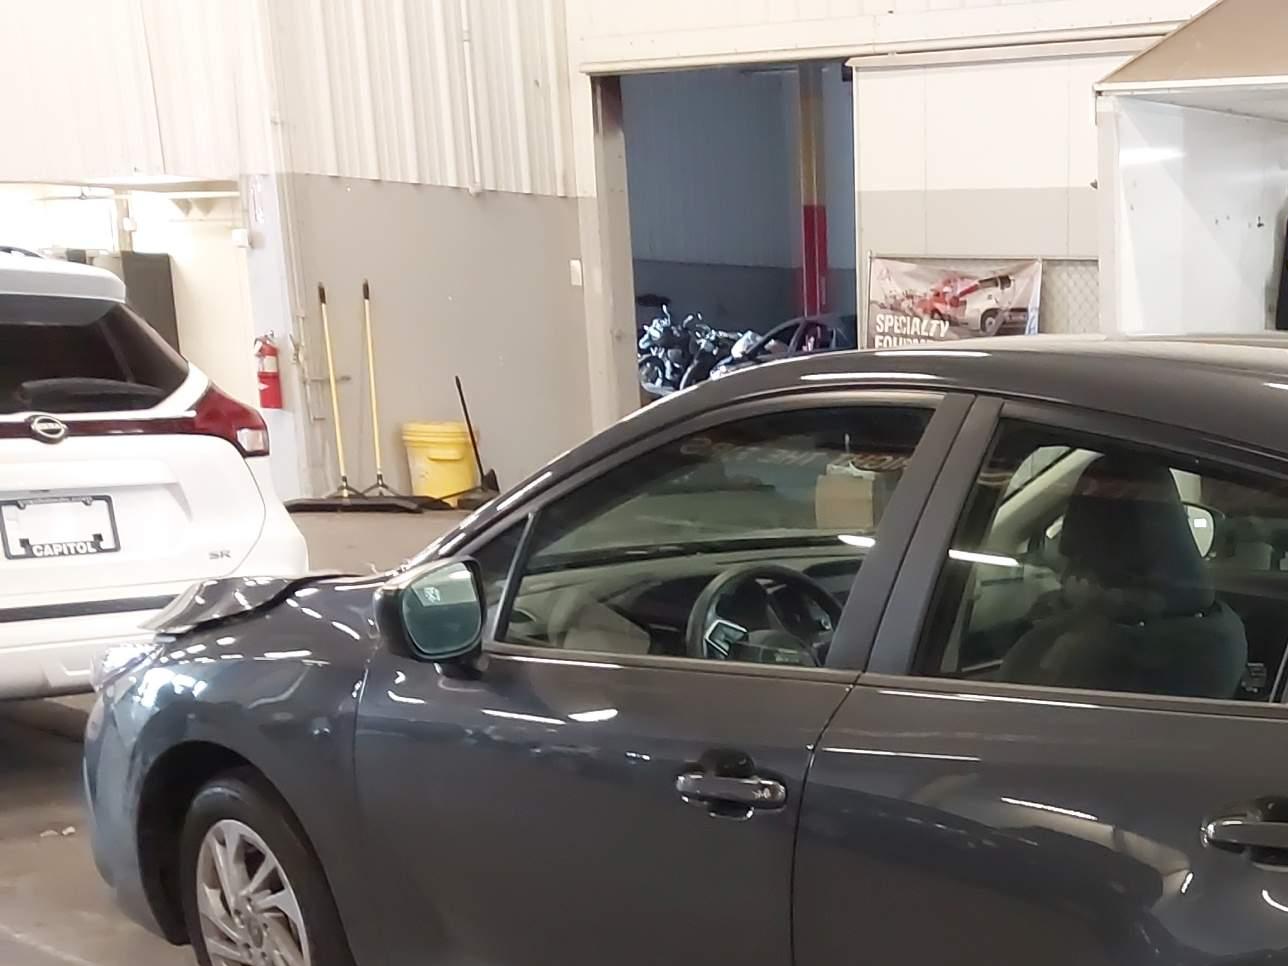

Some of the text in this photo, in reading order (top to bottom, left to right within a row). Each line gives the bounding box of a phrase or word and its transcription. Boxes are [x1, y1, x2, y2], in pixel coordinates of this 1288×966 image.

[876, 313, 950, 337] SPECIALTY
[32, 540, 97, 557] CAPITOL
[209, 550, 231, 560] SR
